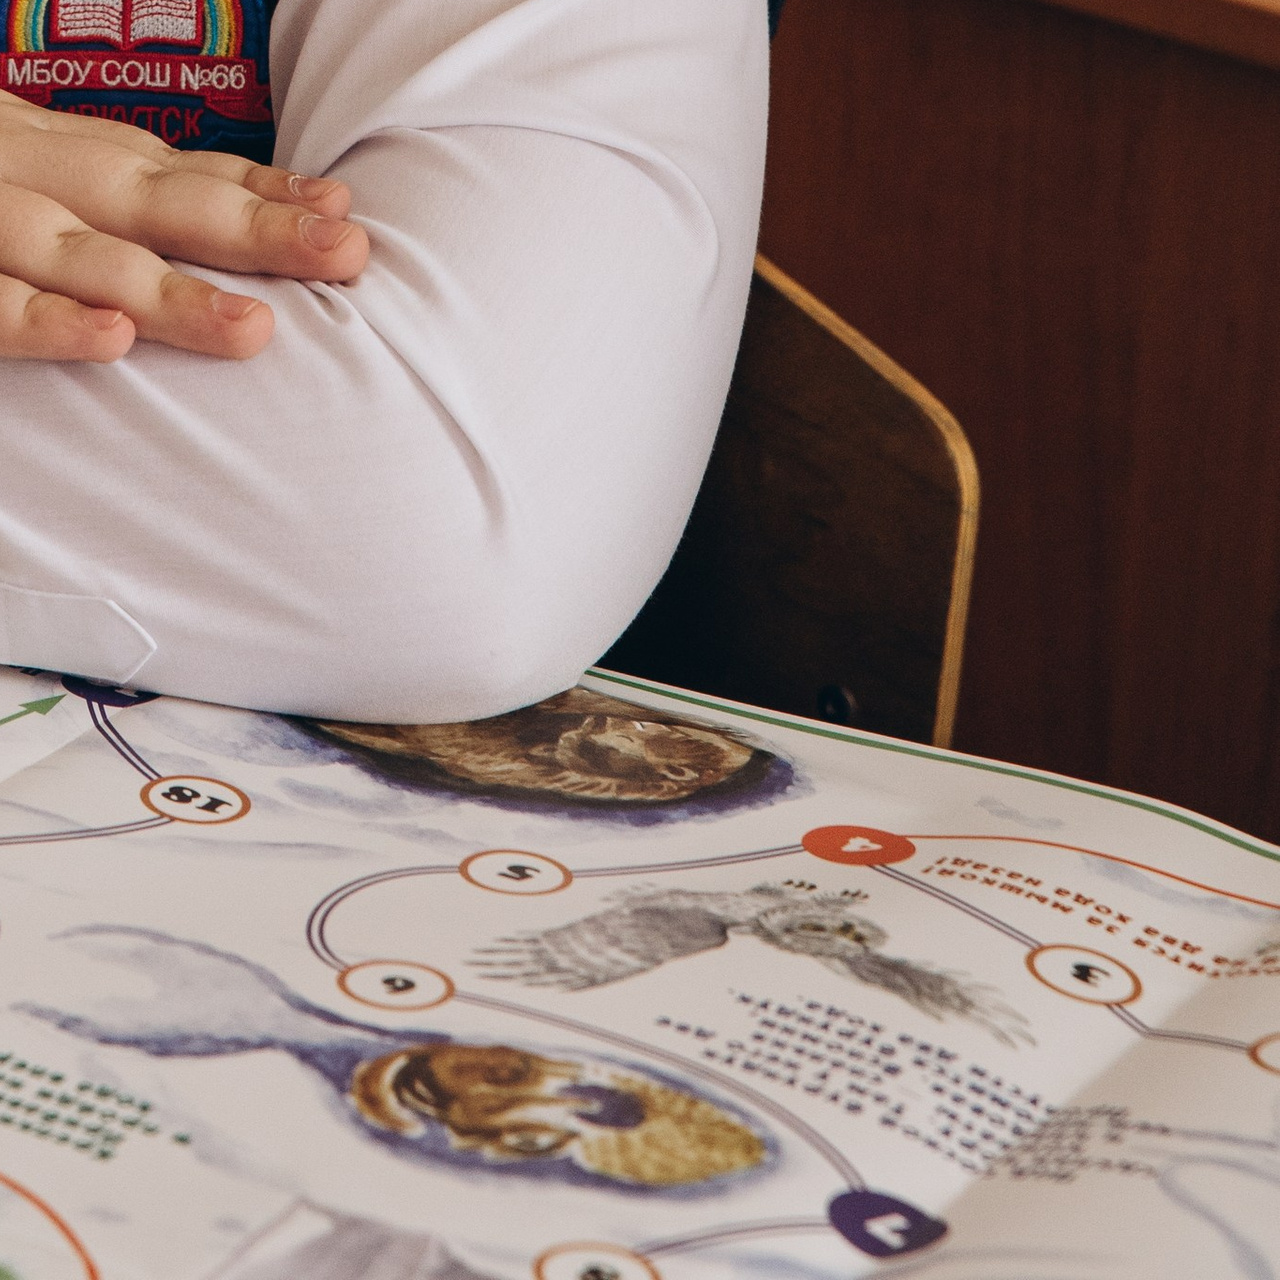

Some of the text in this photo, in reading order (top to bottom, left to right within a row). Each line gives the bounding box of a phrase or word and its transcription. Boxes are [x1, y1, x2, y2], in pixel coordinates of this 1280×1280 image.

[6, 58, 247, 91] МБОУ СОШ №66
[160, 784, 234, 815] 18
[497, 864, 541, 881] 5
[934, 855, 1043, 887] назад!
[920, 864, 1075, 914] мышкой!
[1053, 887, 1132, 925] хода
[1142, 924, 1203, 954] два
[1069, 962, 1111, 989] 3
[863, 1211, 912, 1250] 7
